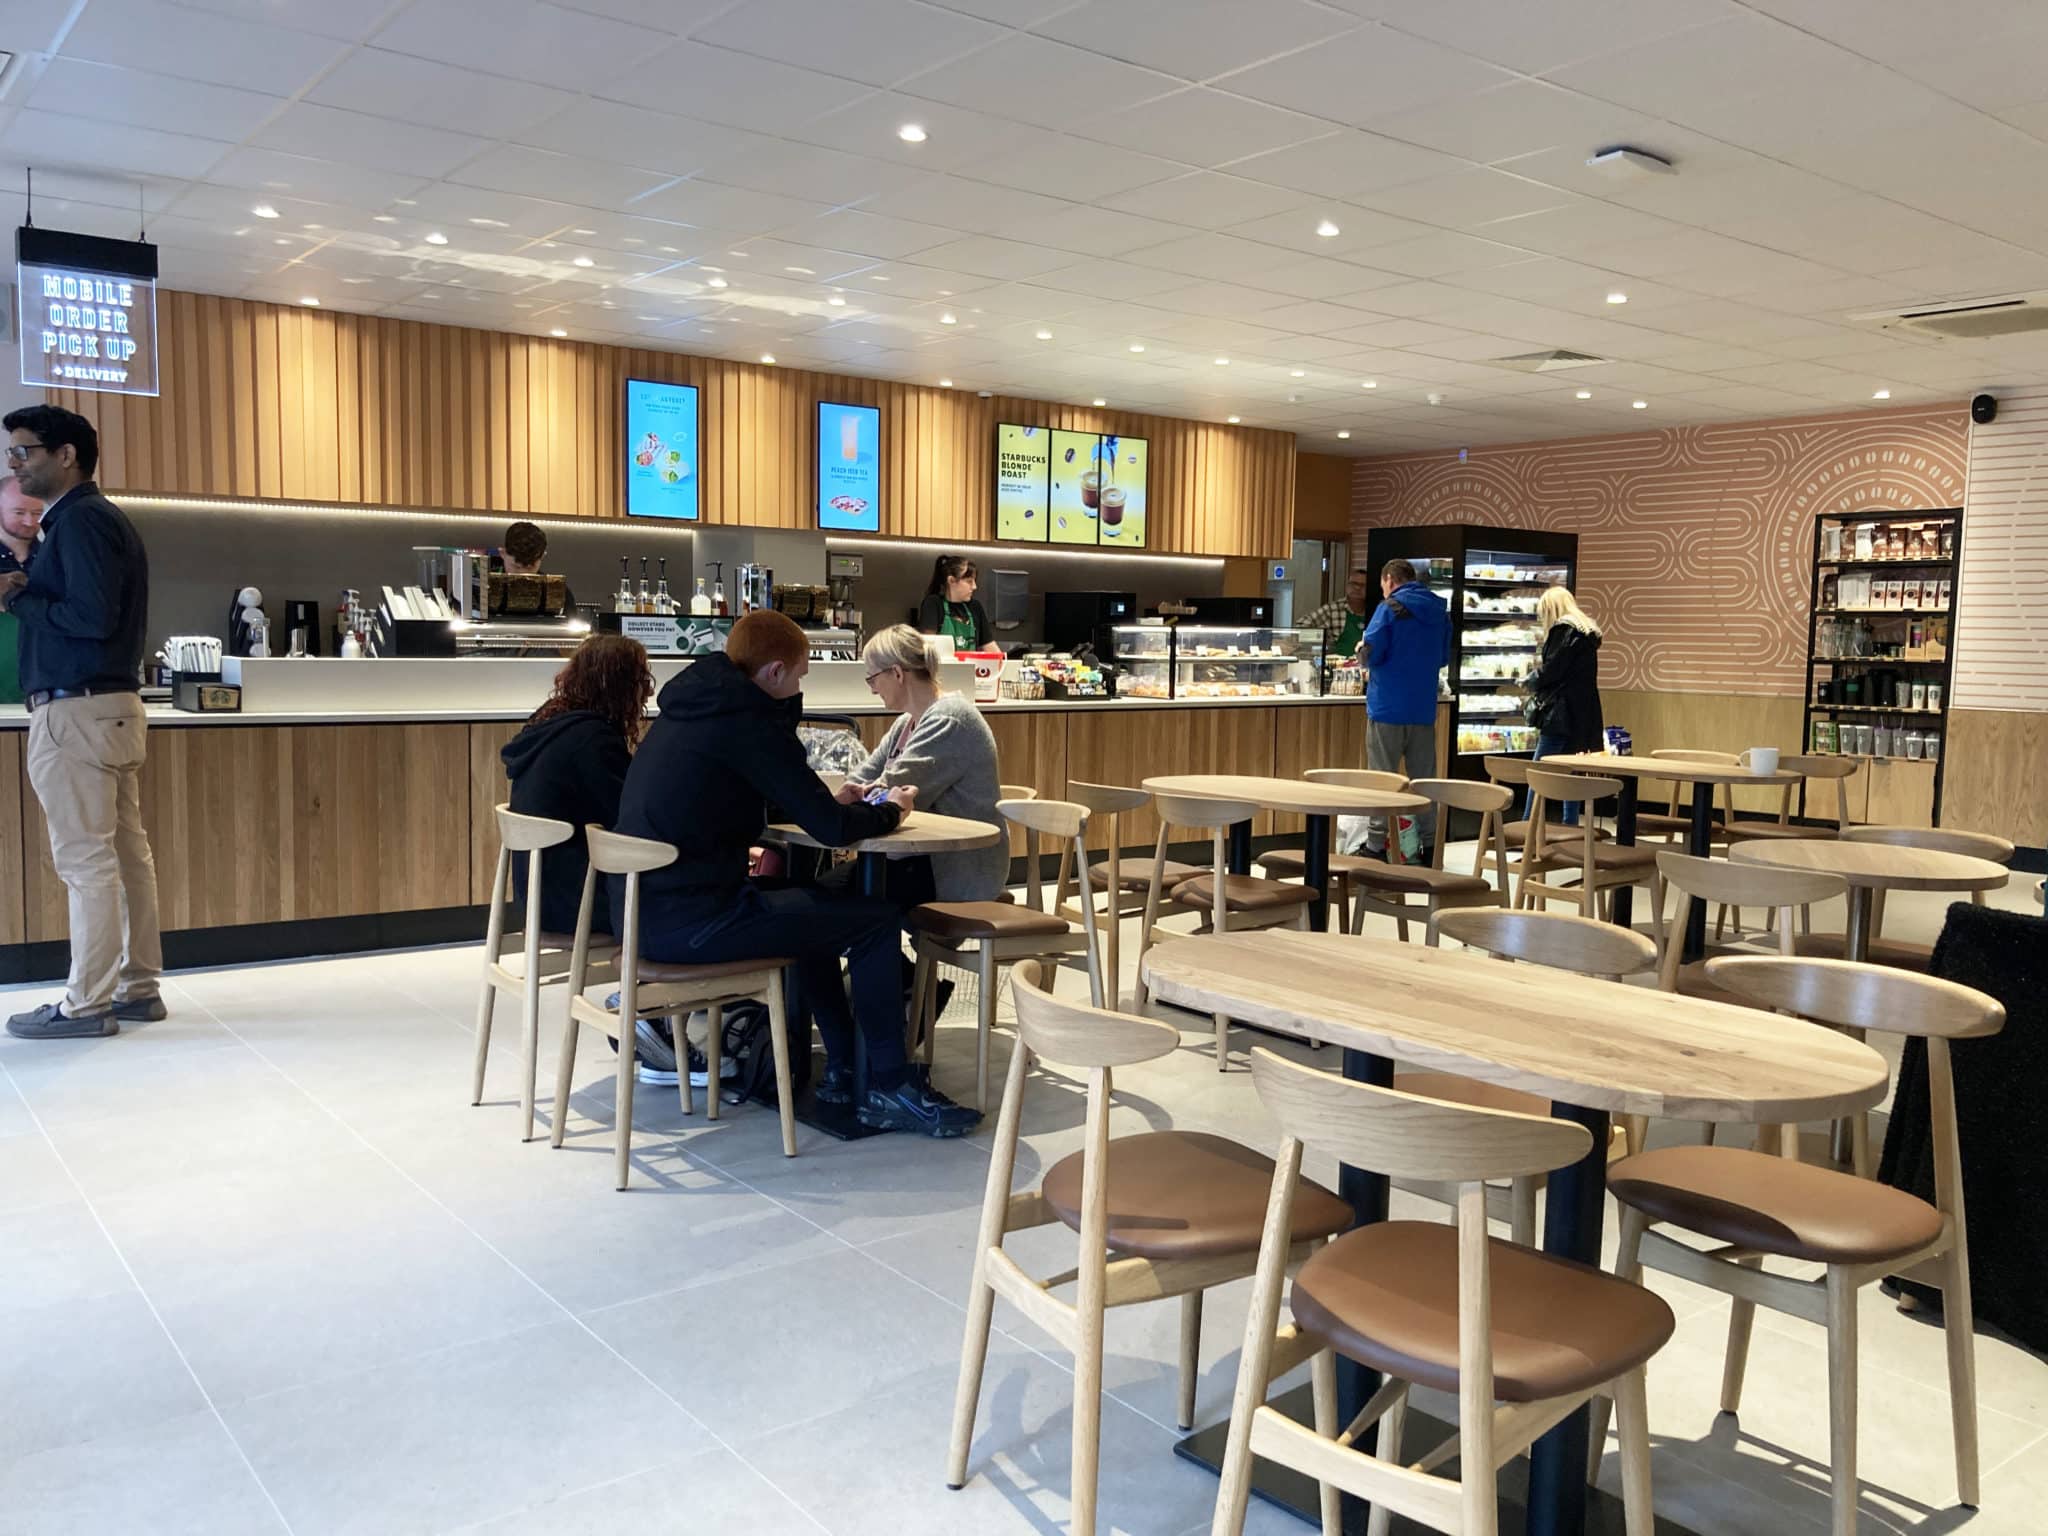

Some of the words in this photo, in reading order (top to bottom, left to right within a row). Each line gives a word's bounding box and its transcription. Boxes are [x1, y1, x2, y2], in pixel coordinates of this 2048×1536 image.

[43, 275, 133, 307] MOBILE
[50, 303, 129, 334] ORDER
[42, 331, 100, 358] PICK
[106, 337, 137, 361] UP
[65, 366, 128, 383] DELIVERY
[1001, 453, 1046, 464] STARBUCKS
[1001, 461, 1032, 471] BLONDE
[1001, 470, 1026, 478] ROAST
